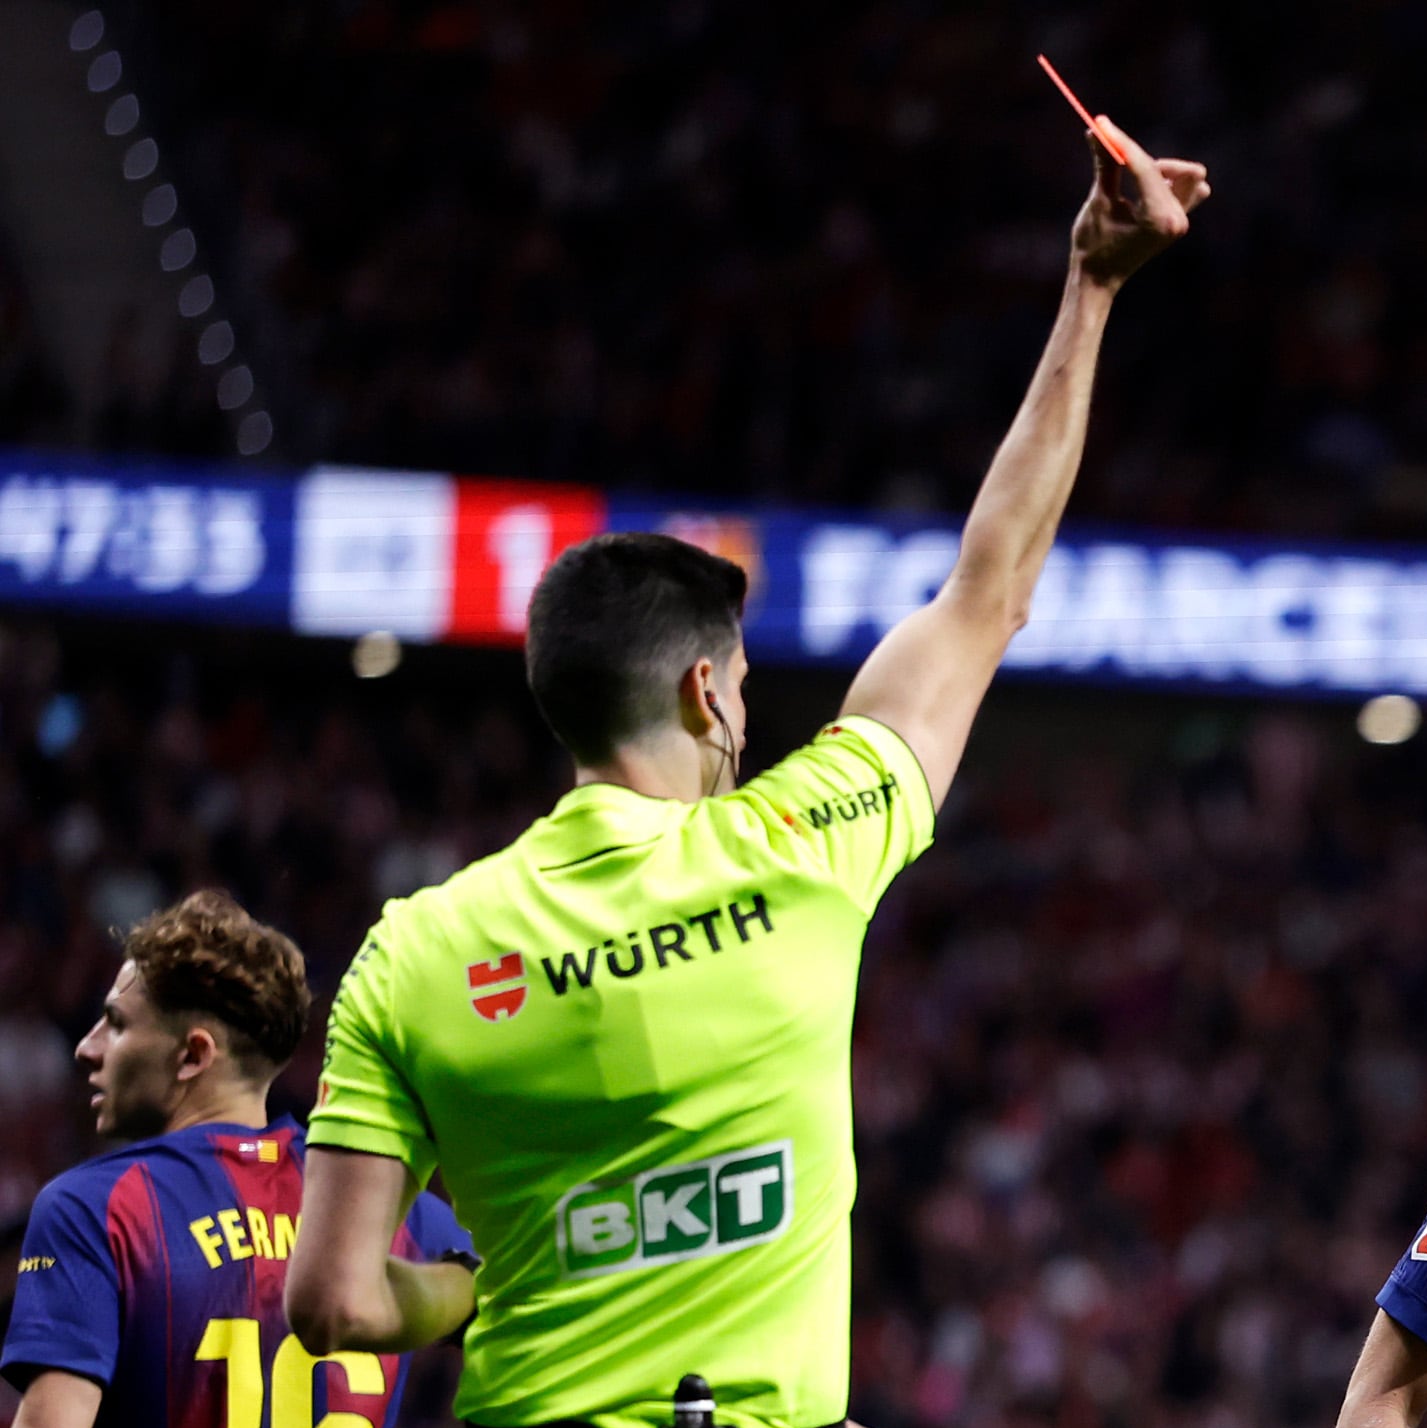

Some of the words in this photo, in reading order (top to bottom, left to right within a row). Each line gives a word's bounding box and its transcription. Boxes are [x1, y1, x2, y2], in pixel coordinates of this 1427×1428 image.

[798, 773, 901, 830] WÜRTH
[541, 893, 773, 996] WÜRTH
[189, 1206, 302, 1270] FERM
[569, 1164, 780, 1257] BKT
